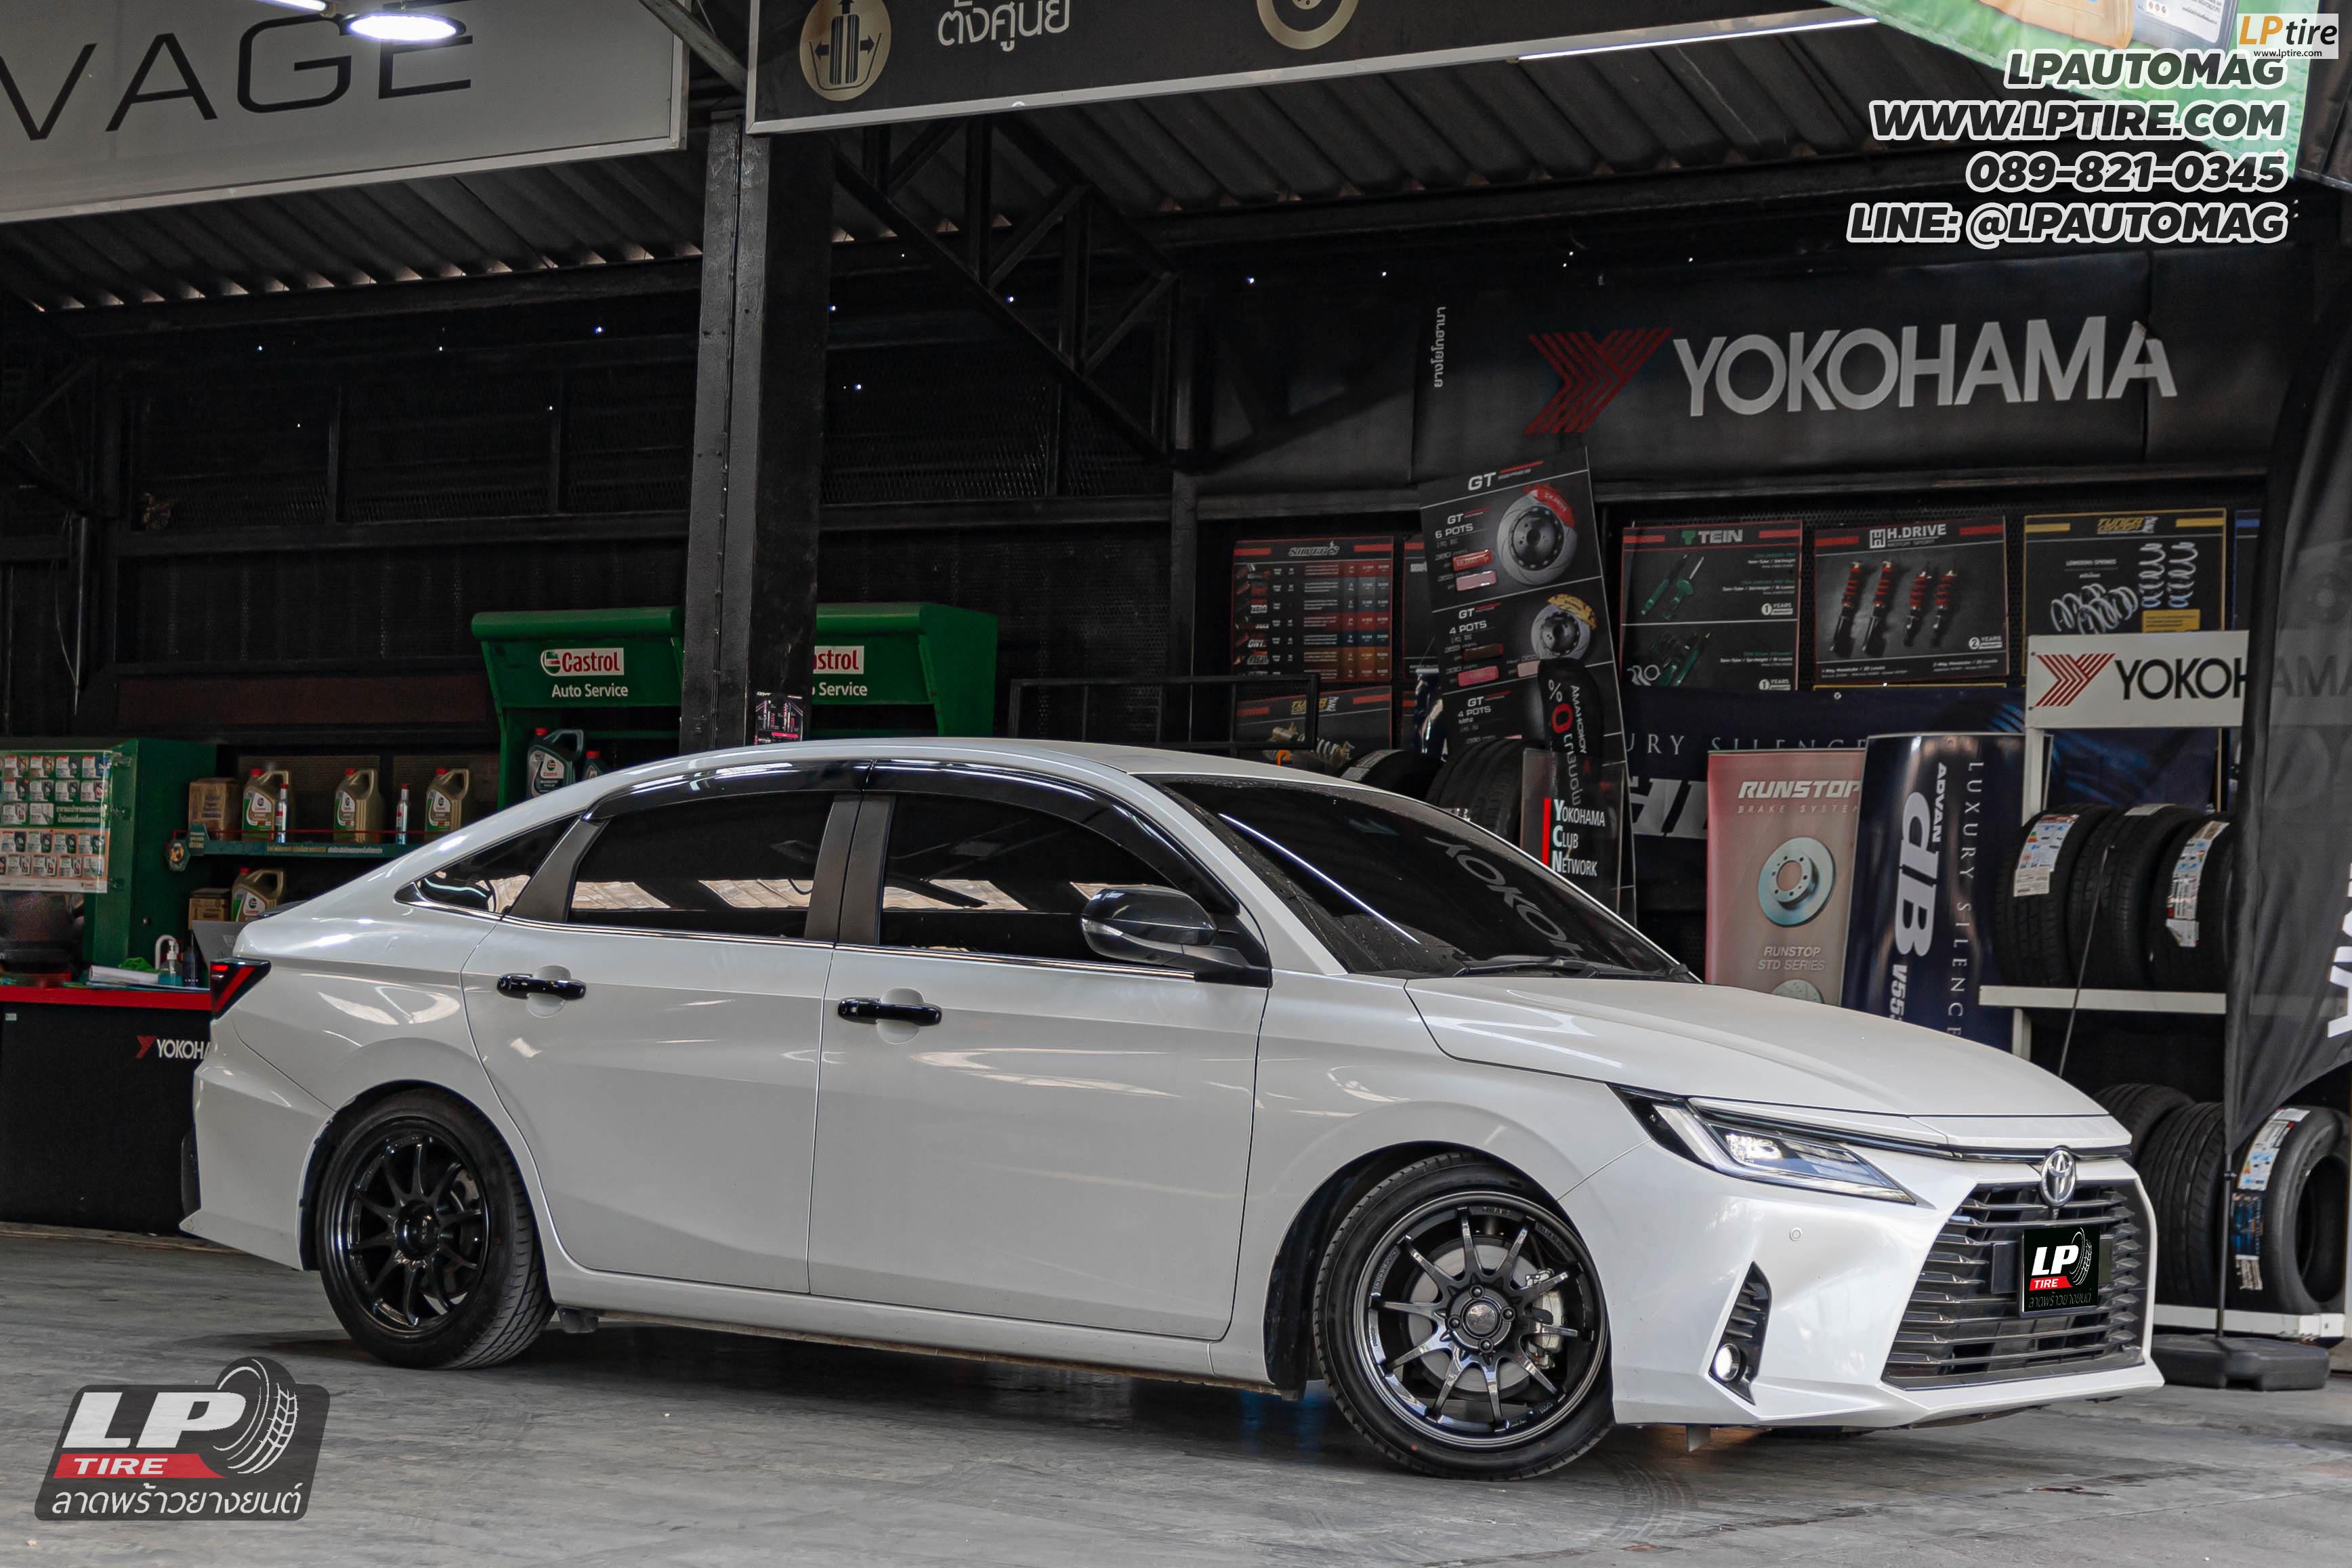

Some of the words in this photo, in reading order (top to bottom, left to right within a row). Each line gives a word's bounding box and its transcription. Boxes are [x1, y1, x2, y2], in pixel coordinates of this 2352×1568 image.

[1673, 316, 2177, 417] YOKOHAMA
[1467, 472, 1496, 491] GT
[1447, 513, 1464, 525] GT
[1435, 530, 1442, 539] 6
[1445, 523, 1473, 536] POTS
[1698, 530, 1744, 545] TEIN
[1887, 524, 1946, 539] H.DRIVE
[1458, 608, 1475, 619] GT
[1449, 626, 1456, 635] 4
[1459, 620, 1487, 633] POTS
[562, 652, 621, 673] Castrol
[552, 684, 582, 698] Auto
[585, 683, 629, 697] Service
[818, 681, 868, 696] Service
[1467, 696, 1484, 707] GT
[1467, 706, 1492, 717] POTS
[1738, 780, 1862, 799] RUNSTOP
[1738, 805, 1786, 813] BRAKE
[1932, 762, 1948, 843] ADVAN
[1553, 799, 1605, 827] YOKOHAMA
[1959, 762, 1984, 880] LUXURY
[1553, 824, 1578, 849] CLUB
[1552, 851, 1598, 877] NETWORK
[1895, 791, 1939, 957] dB
[1763, 946, 1821, 958] RUNSTOP
[1757, 958, 1781, 971] STD
[1784, 958, 1826, 972] SERIES
